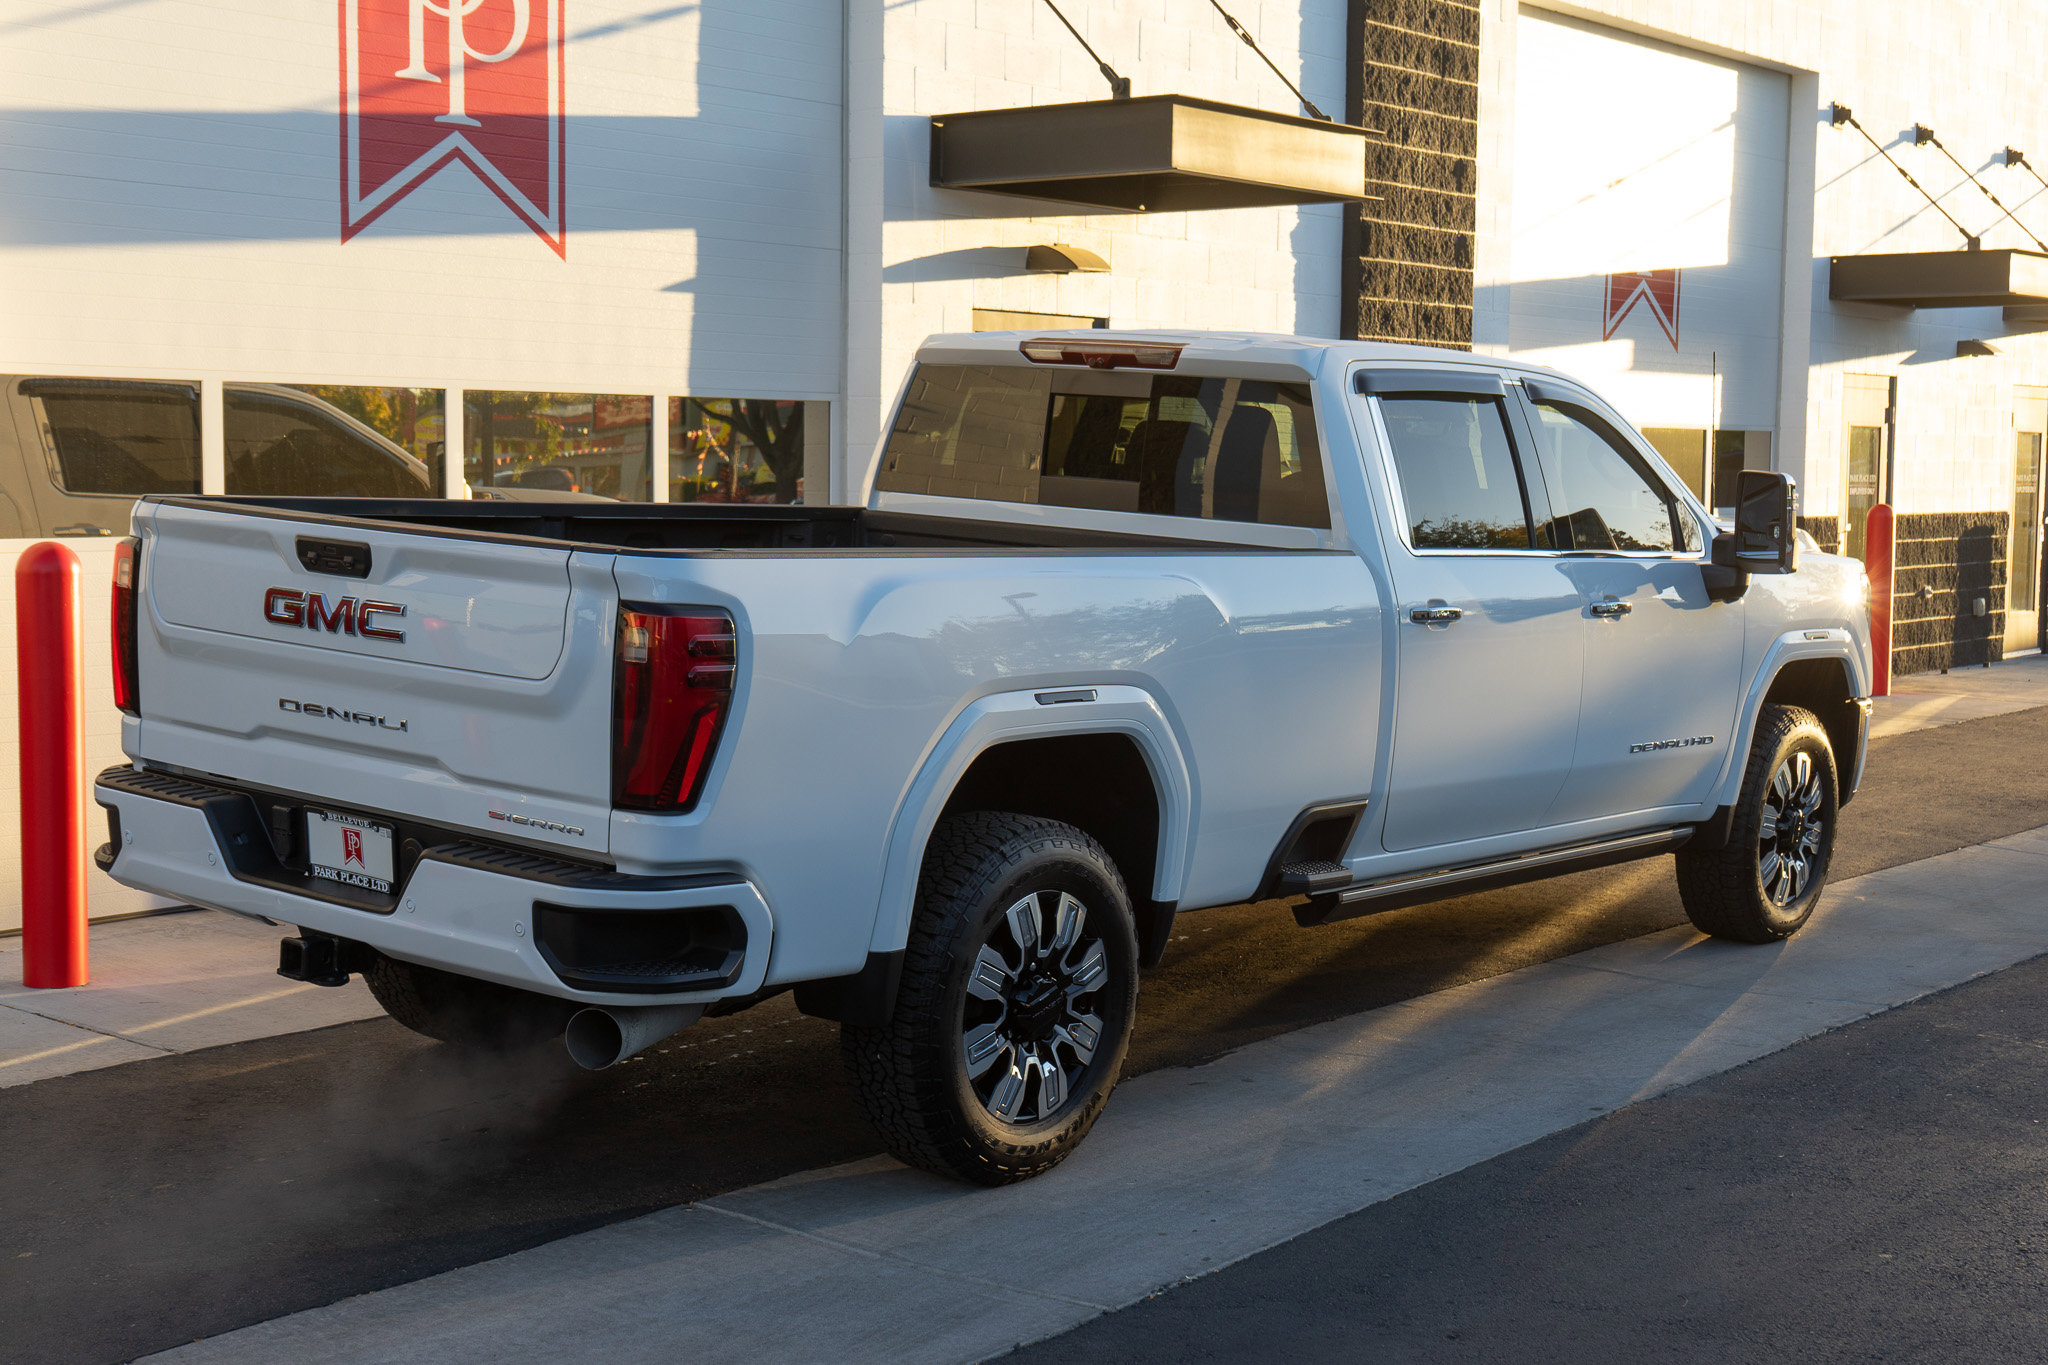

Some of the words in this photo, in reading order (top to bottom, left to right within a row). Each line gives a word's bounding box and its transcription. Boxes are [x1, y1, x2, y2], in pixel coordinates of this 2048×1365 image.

[264, 586, 407, 644] GMC
[279, 698, 408, 732] DENALI
[1630, 738, 1689, 753] DENALI
[1691, 734, 1715, 746] HD
[327, 812, 370, 828] BELLEVUE
[488, 809, 584, 836] SIERRA
[314, 866, 338, 880] PARK
[340, 871, 370, 887] PLACE
[371, 879, 389, 892] LTD
